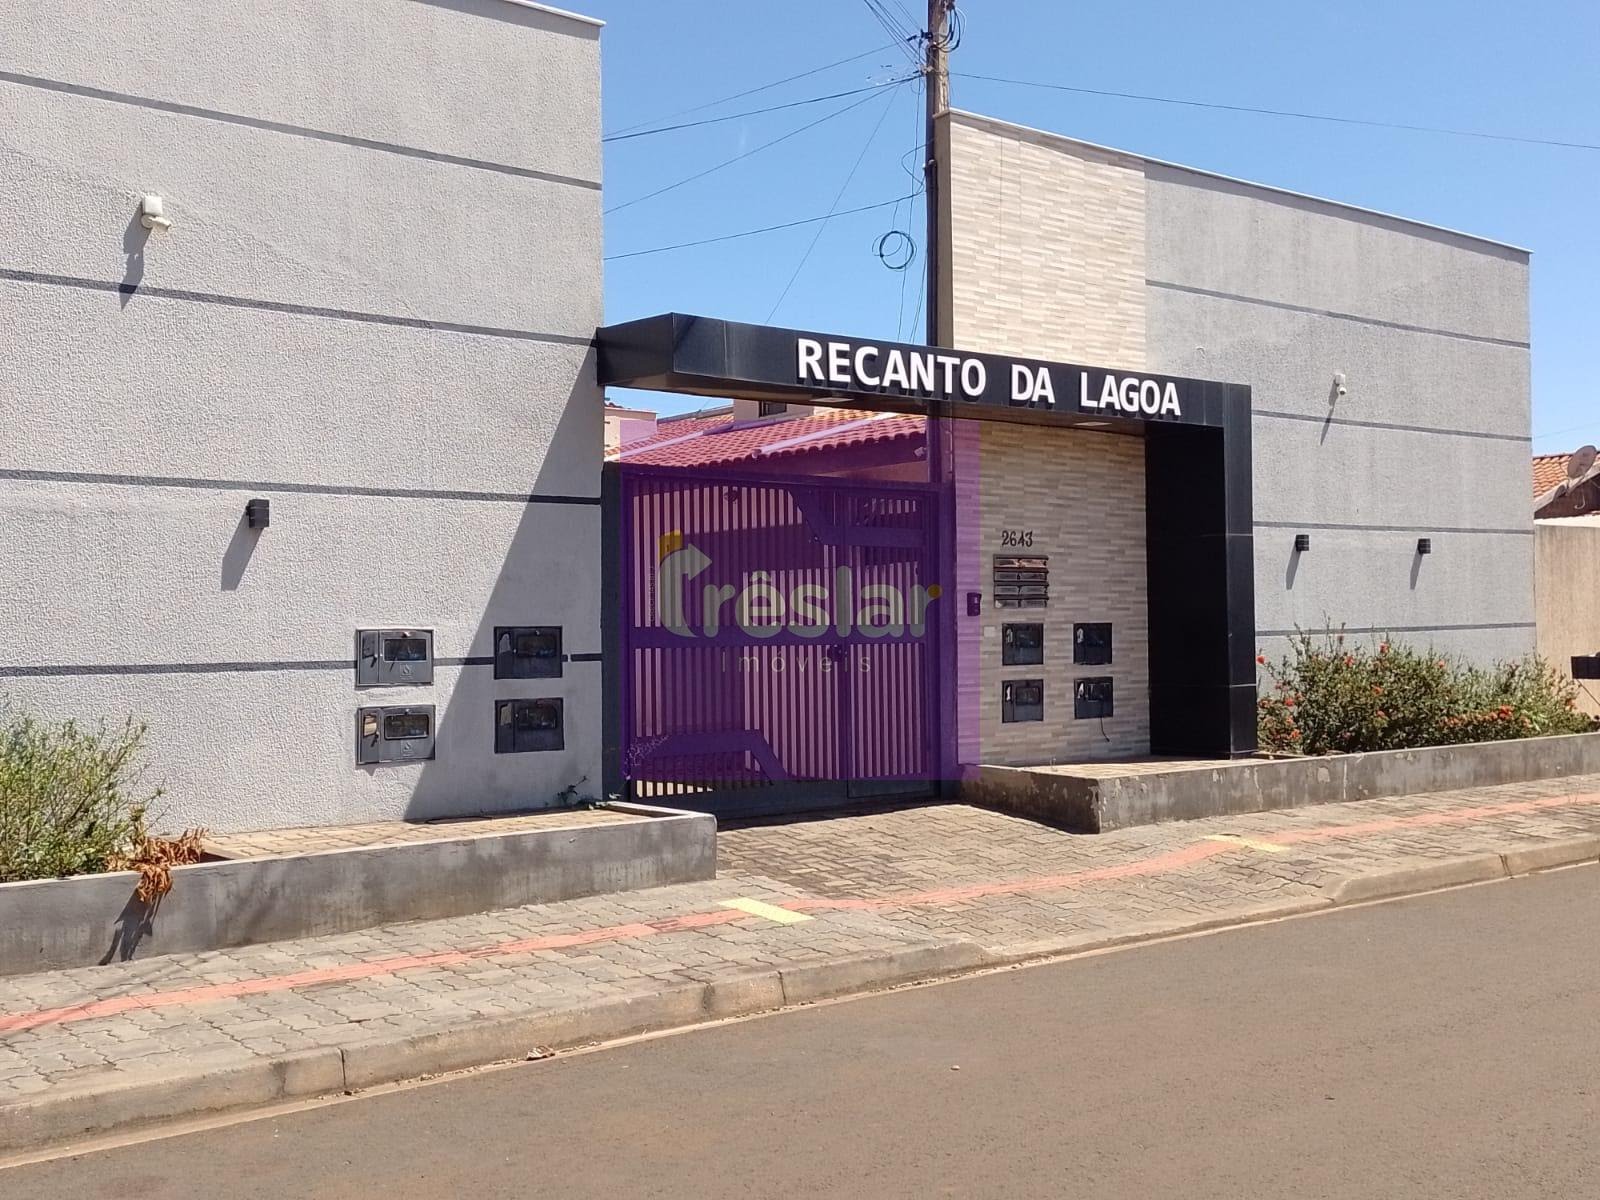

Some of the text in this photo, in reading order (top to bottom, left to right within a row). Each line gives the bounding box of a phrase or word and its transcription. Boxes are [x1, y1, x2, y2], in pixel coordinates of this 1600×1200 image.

[797, 338, 1182, 416] RECANTO DA LAGOA
[1002, 530, 1033, 547] 2643
